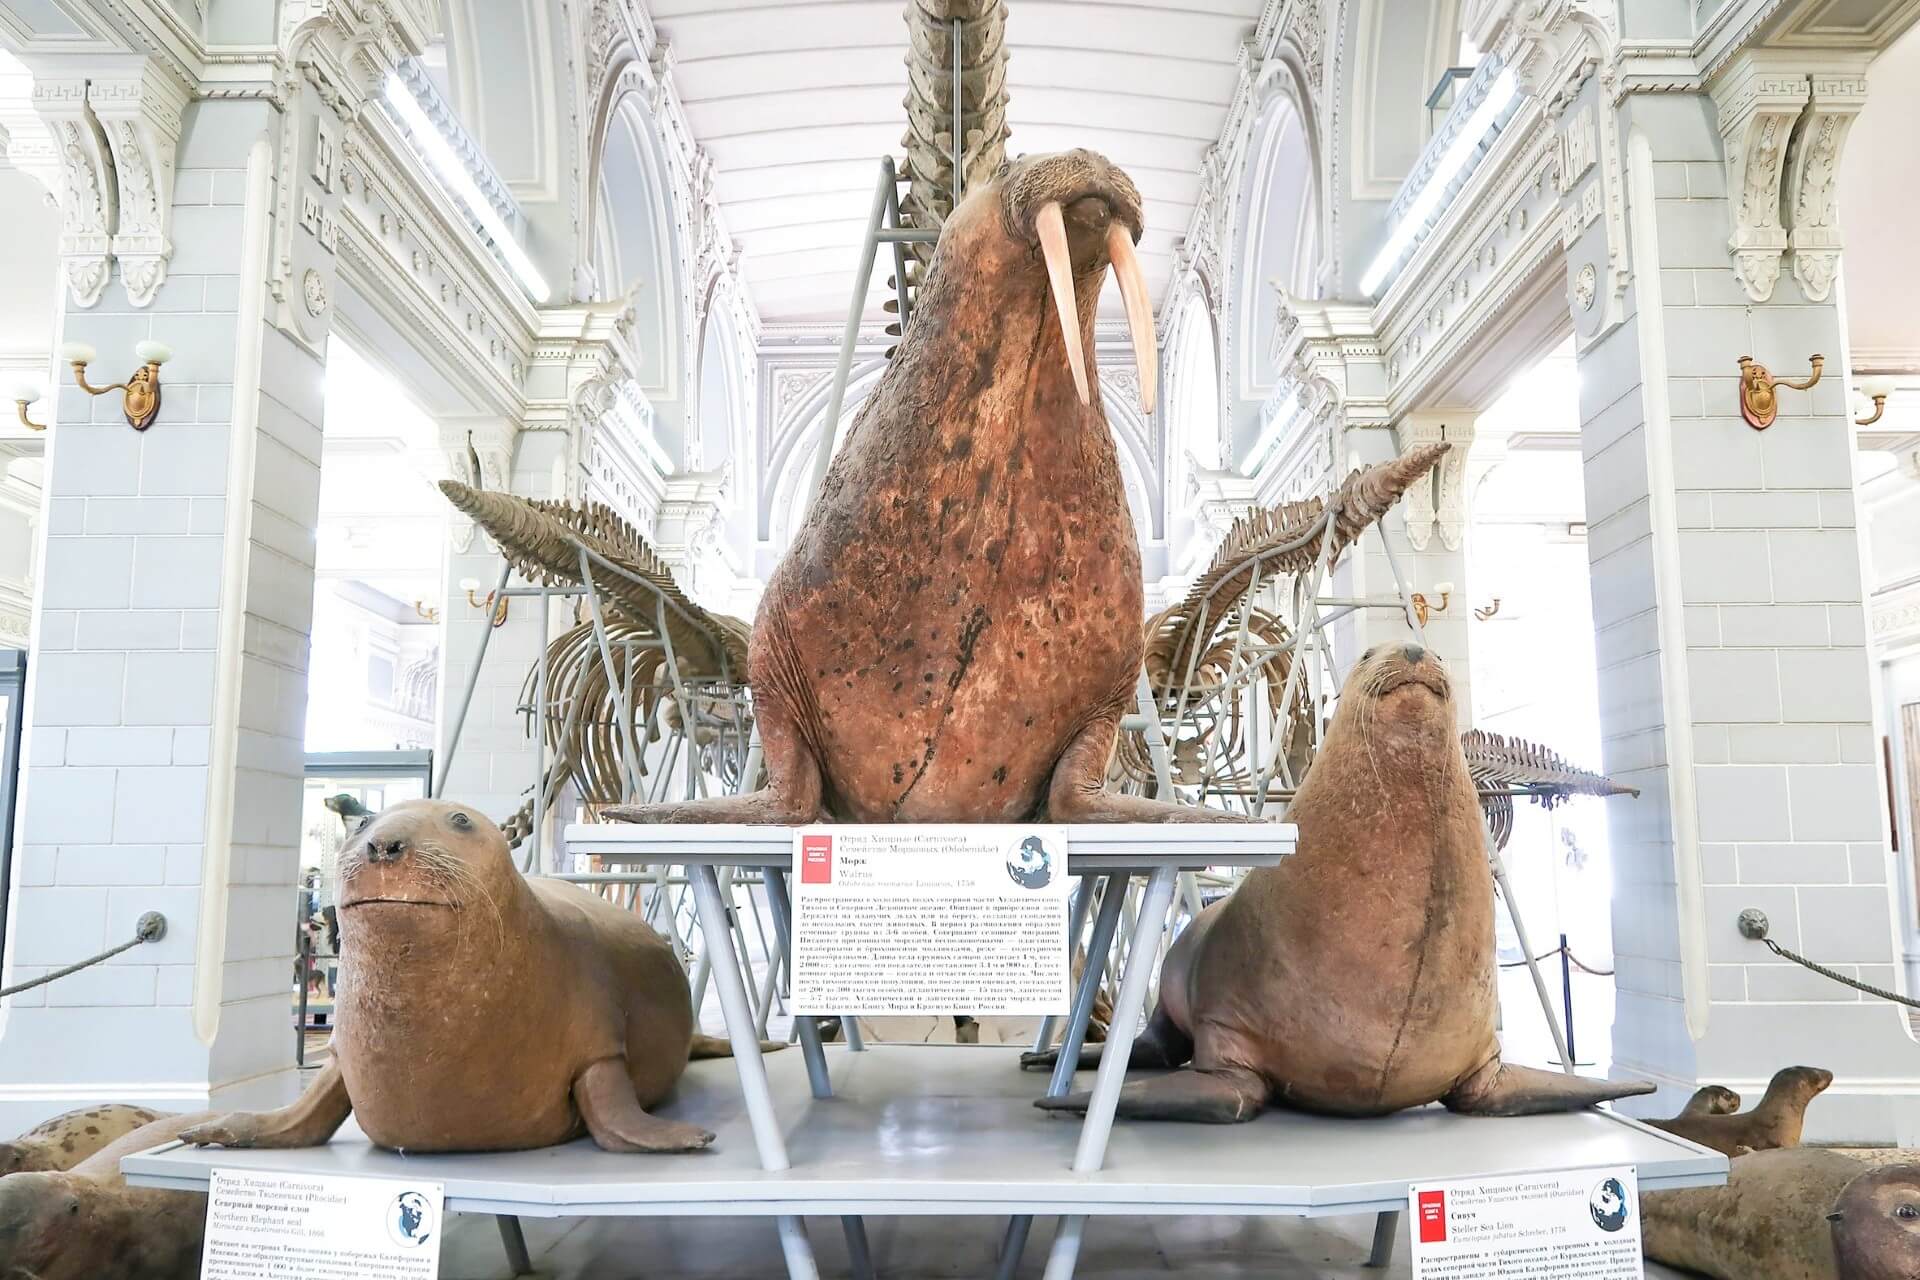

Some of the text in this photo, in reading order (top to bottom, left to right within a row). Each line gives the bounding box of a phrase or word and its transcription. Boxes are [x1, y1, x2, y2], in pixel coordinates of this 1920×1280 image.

[840, 857, 867, 866] Морж
[840, 870, 872, 878] Walrus
[217, 1177, 324, 1191] Отряд Хищные (Carnivora)
[1450, 1181, 1559, 1198] Отряд Хищные (Carnivora)
[214, 1198, 253, 1209] Северный
[256, 1202, 288, 1212] морской
[213, 1211, 302, 1226] Northern Elephant seal
[1451, 1212, 1476, 1221] Сивуч
[1452, 1221, 1514, 1234] Steller Sea Lion
